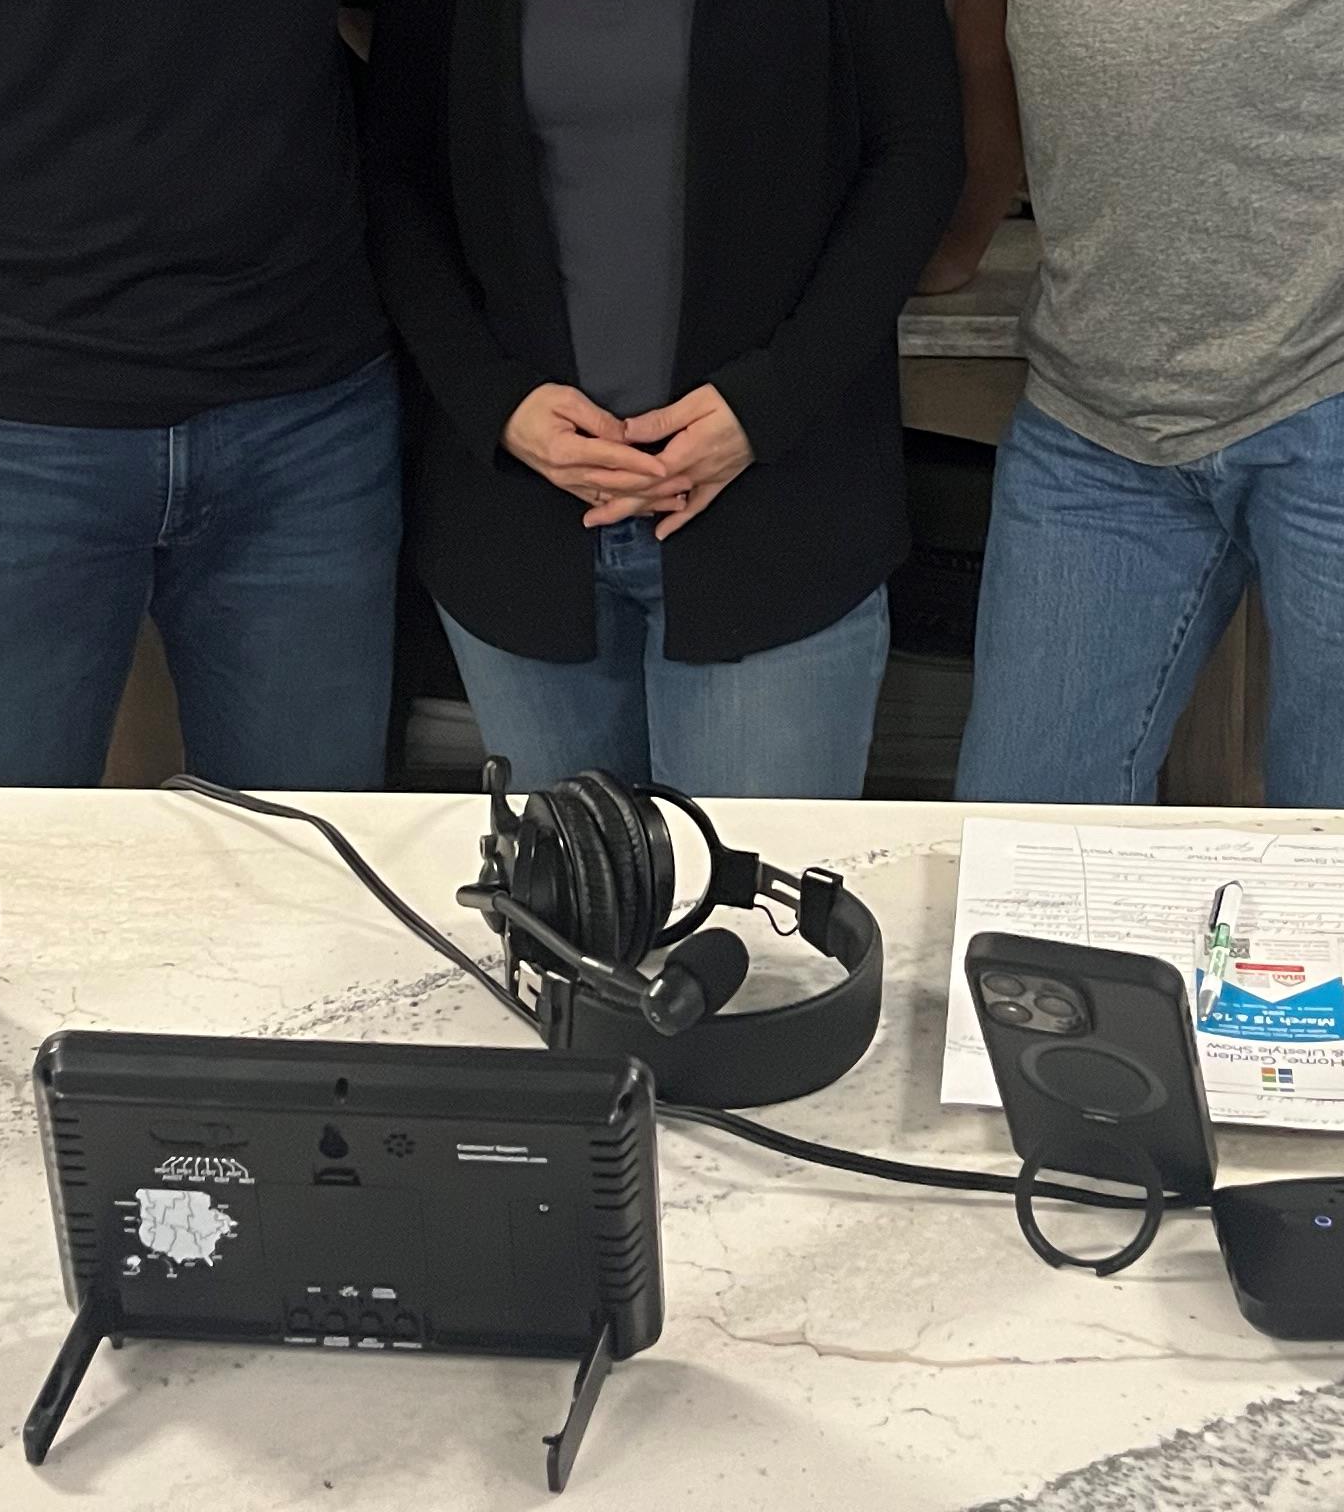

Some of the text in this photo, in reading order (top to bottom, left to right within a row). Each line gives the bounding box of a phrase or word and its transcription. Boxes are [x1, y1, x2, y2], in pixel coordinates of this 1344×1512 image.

[1279, 1016, 1336, 1027] March
[1206, 1042, 1344, 1058] & Lifestyle Show
[1206, 1051, 1277, 1065] Garden
